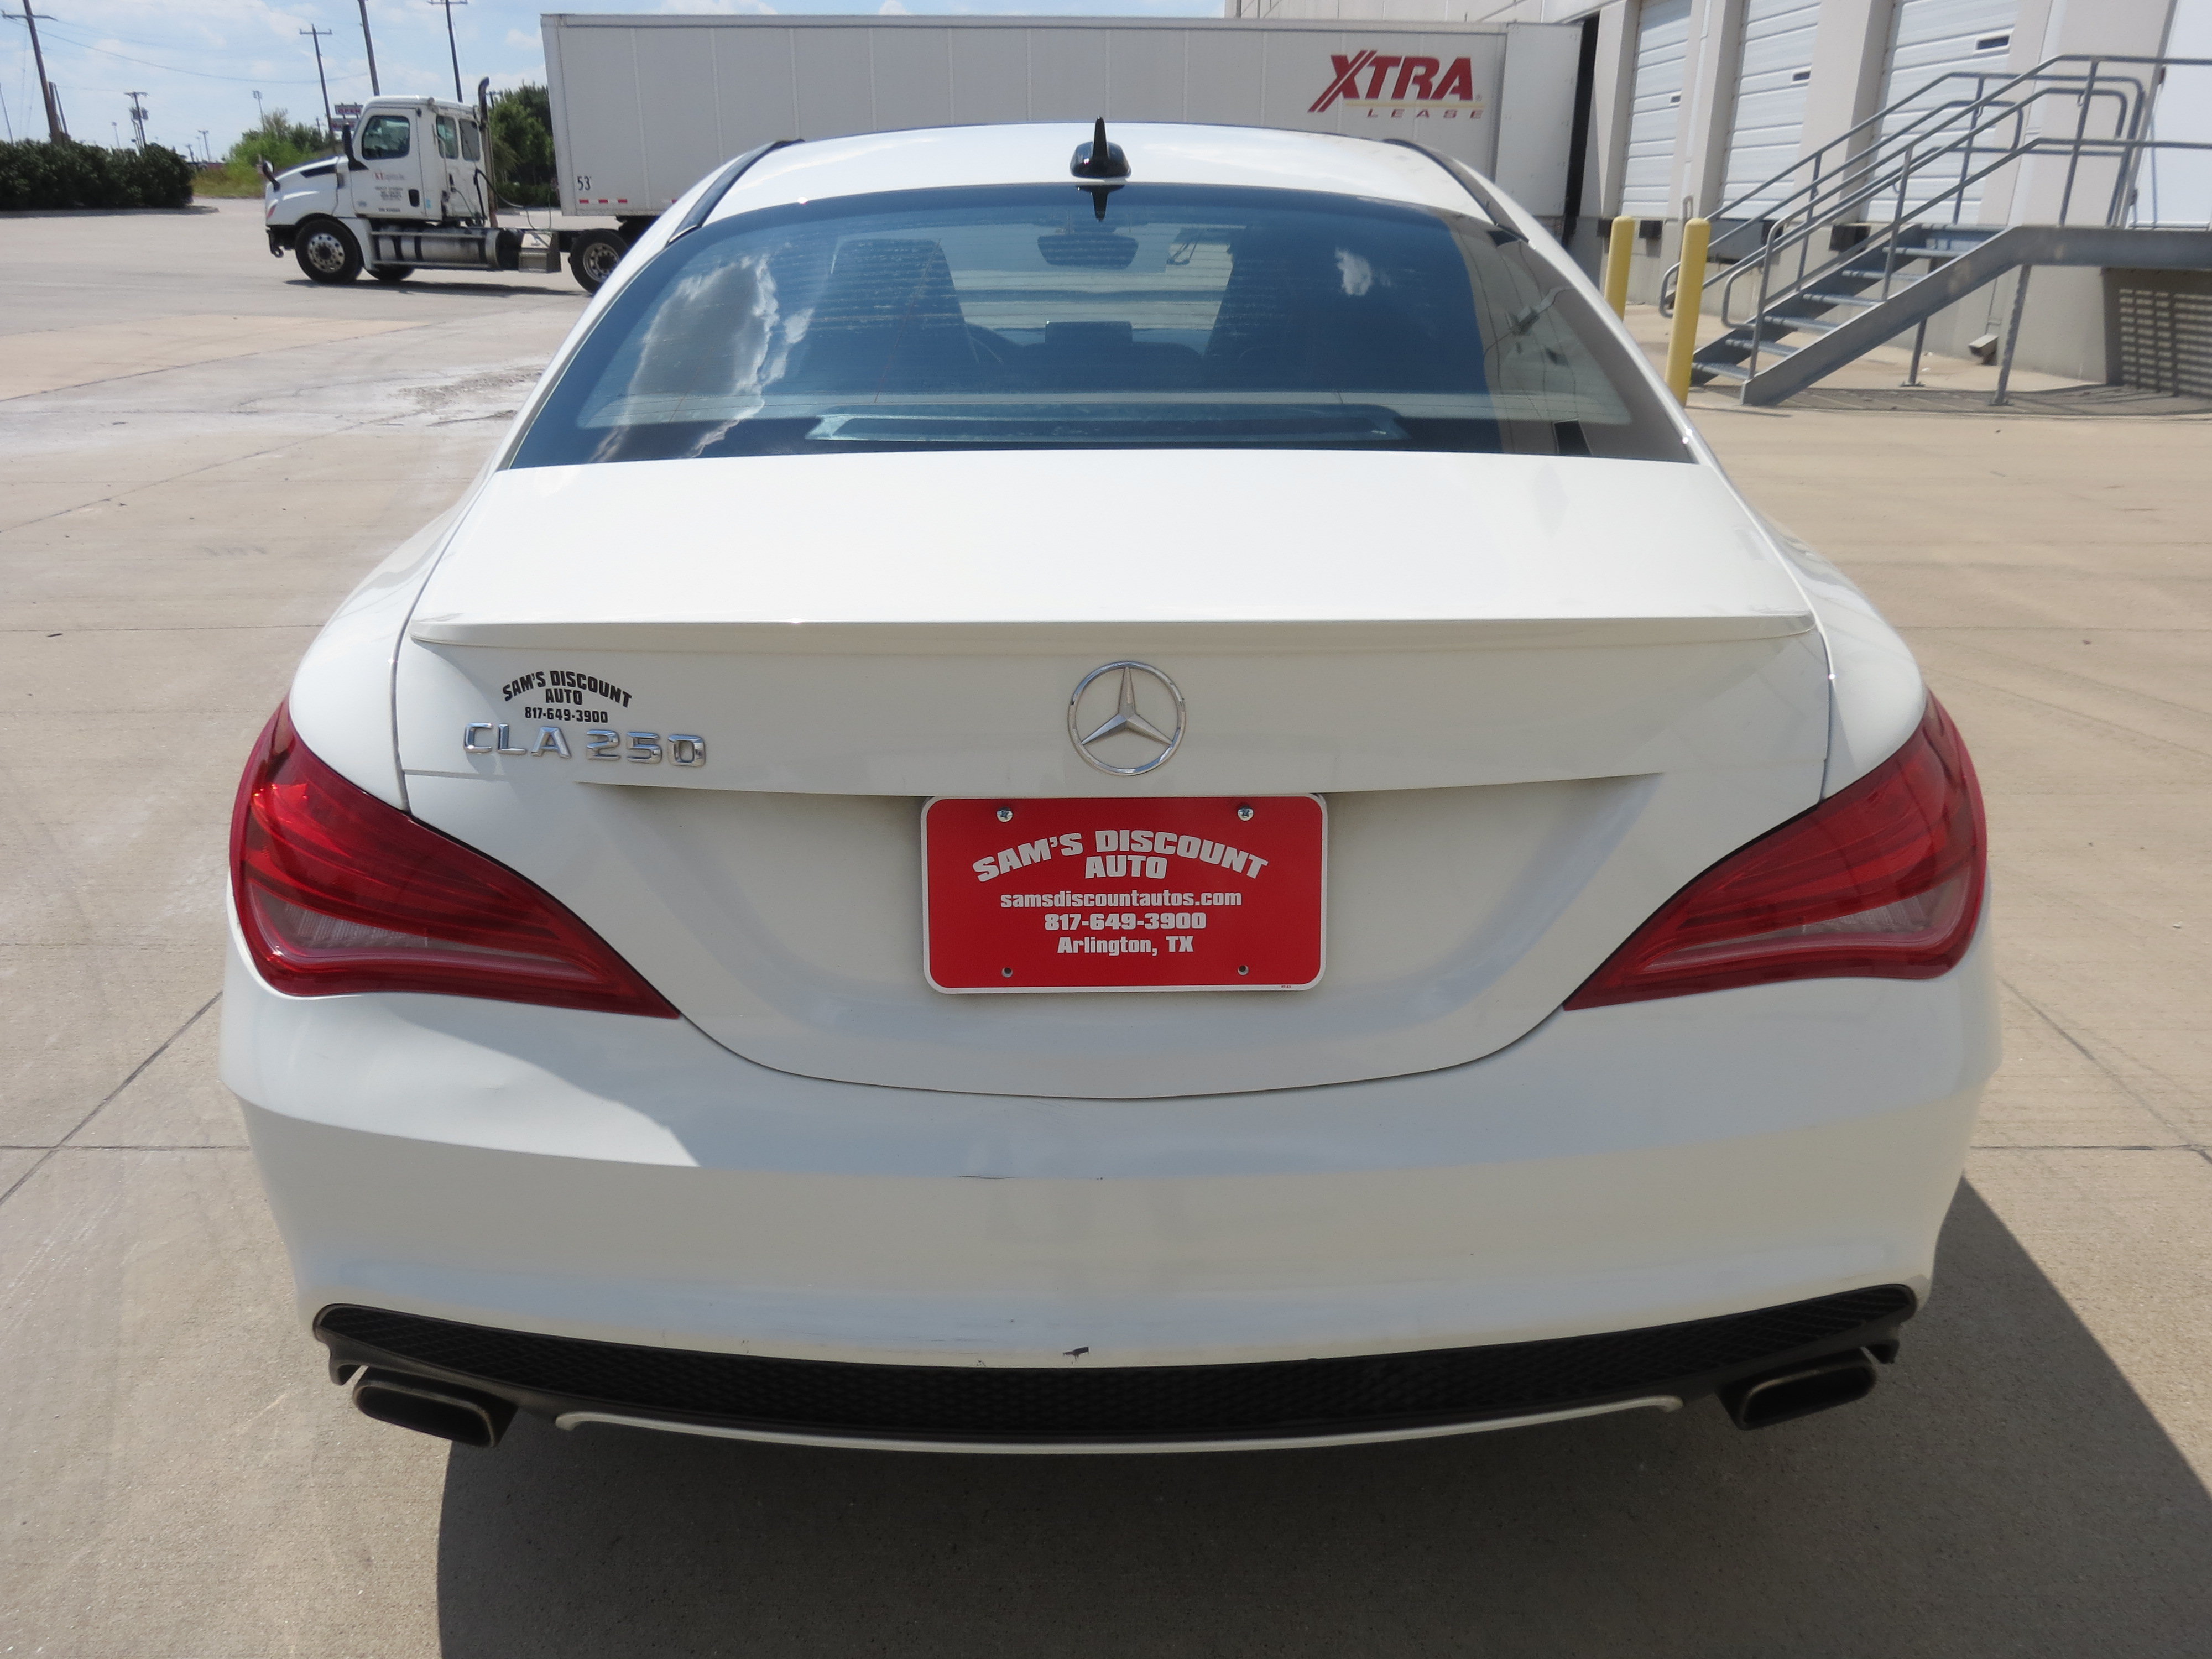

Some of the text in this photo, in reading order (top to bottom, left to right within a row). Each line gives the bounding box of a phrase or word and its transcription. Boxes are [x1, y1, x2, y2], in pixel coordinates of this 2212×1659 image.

[1307, 50, 1474, 113] XTRA
[1367, 108, 1484, 119] LEASE
[503, 670, 633, 708] SAM'S DISCOUNT
[546, 688, 583, 705] AUTO
[525, 707, 608, 723] 817-649-3900
[463, 722, 706, 767] CLA 250
[972, 830, 1269, 882] SAM'S DISCOUNT
[1085, 855, 1167, 879] AUTO
[1000, 889, 1242, 908] samsdiscountautos.com
[1044, 913, 1206, 930] 817-649-3900
[1057, 936, 1194, 956] Arlington, TX
